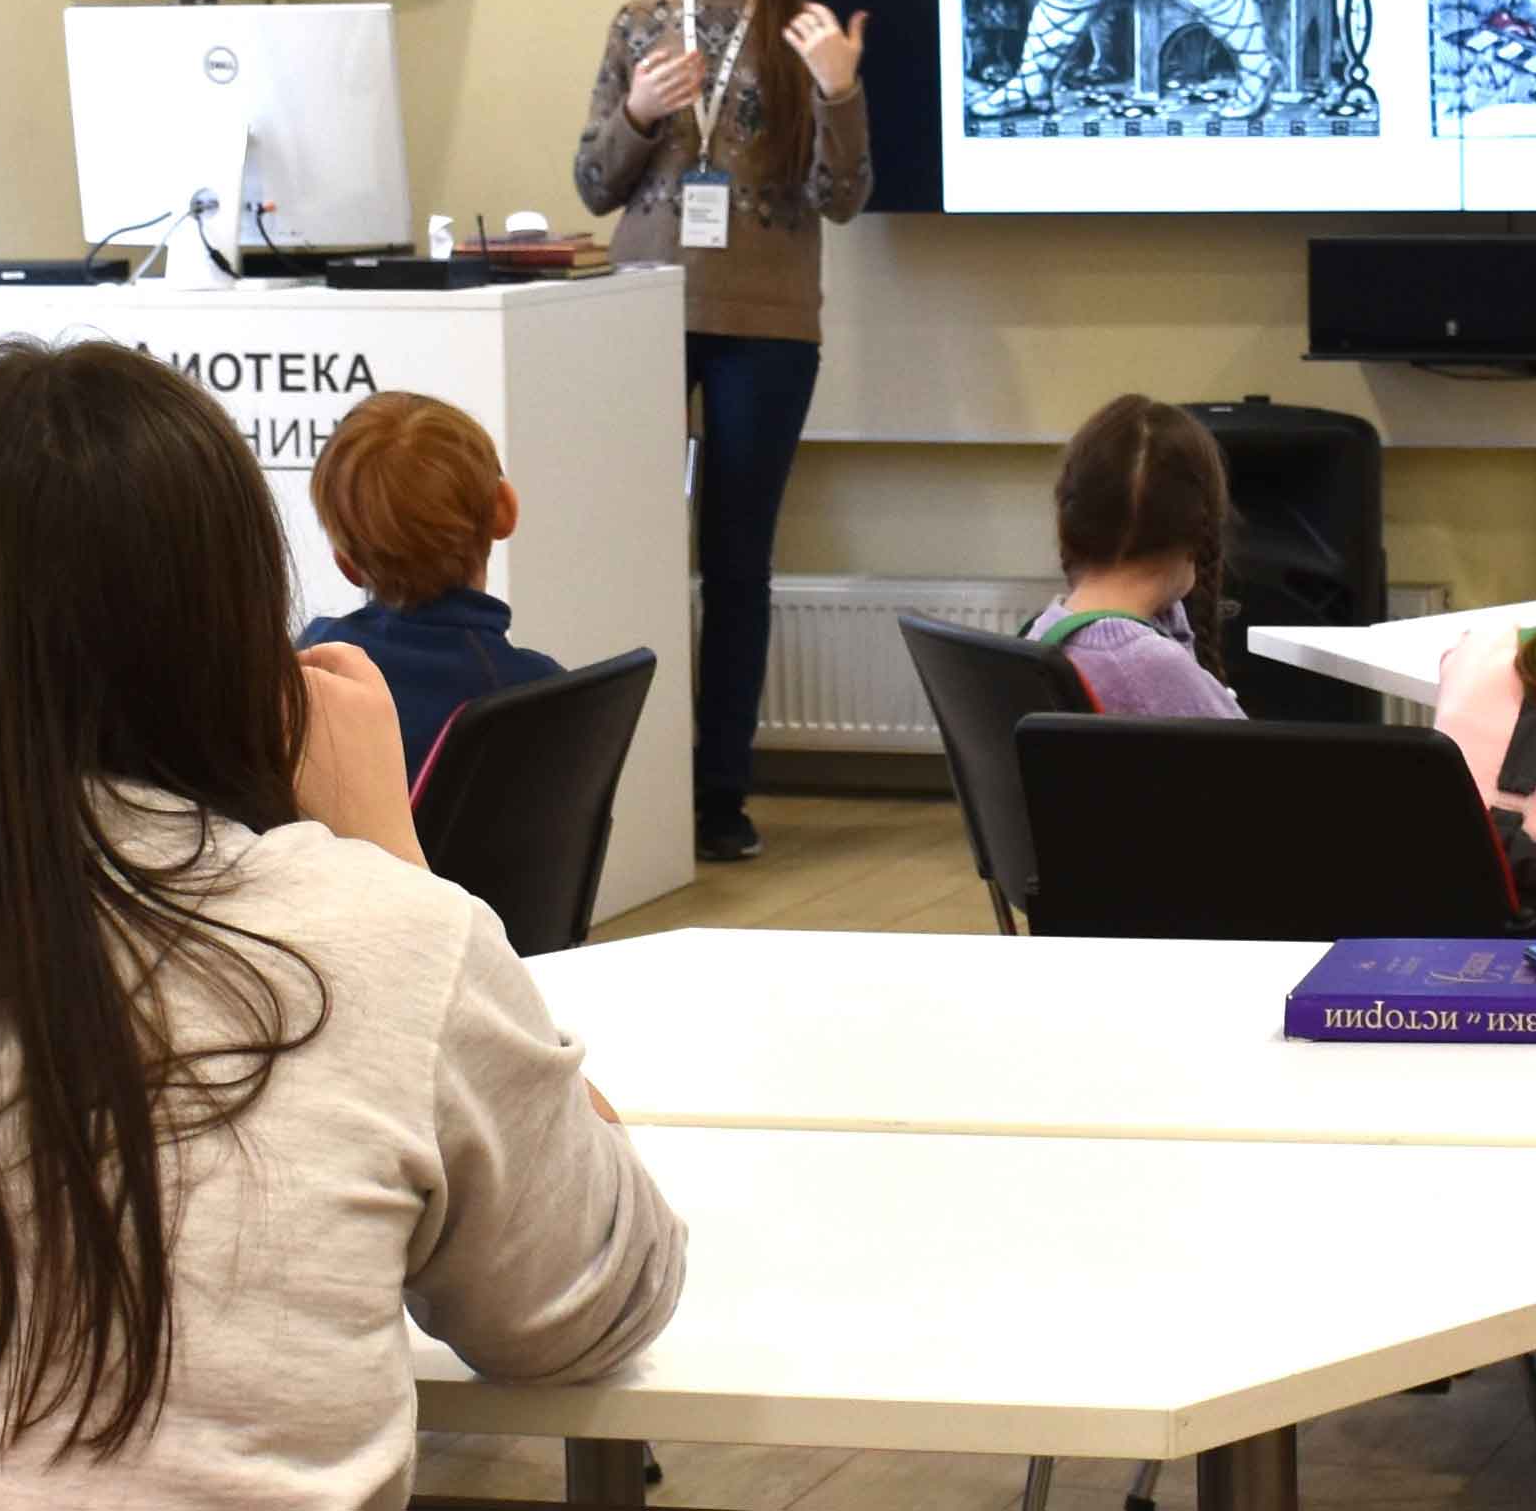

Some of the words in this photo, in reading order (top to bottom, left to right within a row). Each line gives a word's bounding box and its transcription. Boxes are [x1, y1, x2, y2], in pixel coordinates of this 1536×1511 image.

[171, 352, 378, 393] ИОТЕКА
[242, 418, 338, 458] НИН
[1325, 1000, 1458, 1030] истории
[1466, 1012, 1481, 1025] и
